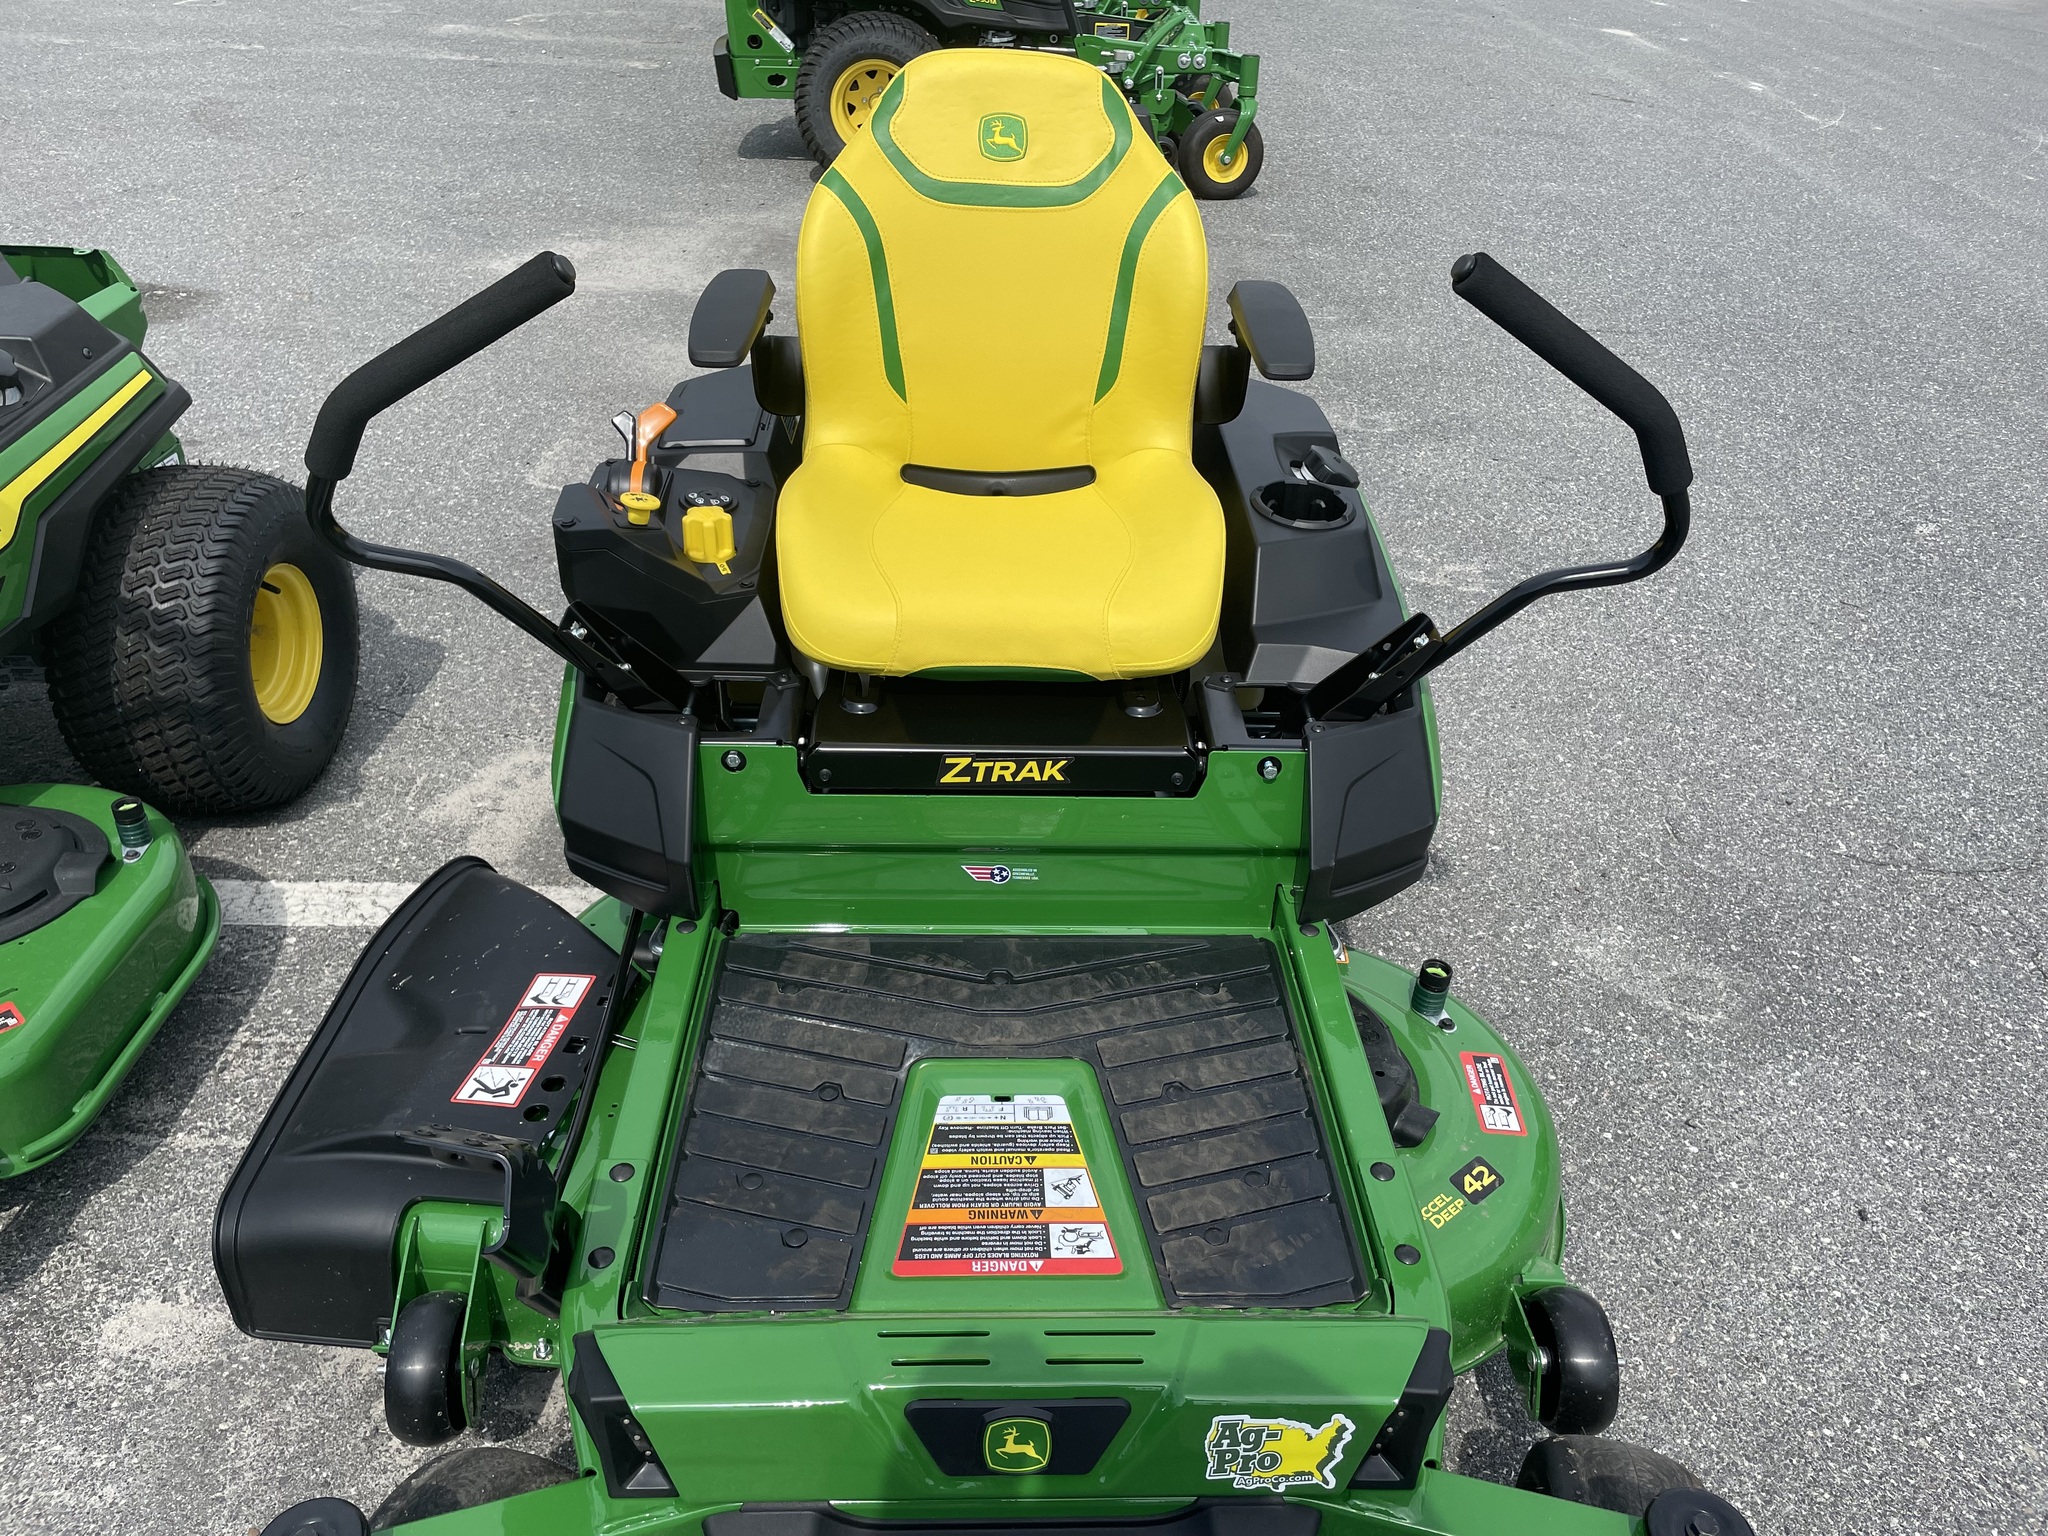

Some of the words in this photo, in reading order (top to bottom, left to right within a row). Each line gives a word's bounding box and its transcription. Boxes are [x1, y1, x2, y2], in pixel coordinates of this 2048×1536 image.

[939, 757, 1068, 783] ZTRAK
[532, 1024, 564, 1062] DANGER
[1465, 1064, 1479, 1088] DANGER
[970, 1156, 1022, 1165] CAUTION
[1463, 1165, 1497, 1195] 42
[968, 1210, 1028, 1219] WARNING
[1421, 1193, 1453, 1221] CCEL
[1428, 1198, 1465, 1230] DEEP
[972, 1260, 1027, 1271] DANGER
[1211, 1420, 1282, 1452] Ag-
[1210, 1449, 1282, 1476] Pro
[1236, 1474, 1313, 1486] AgProCo.com
